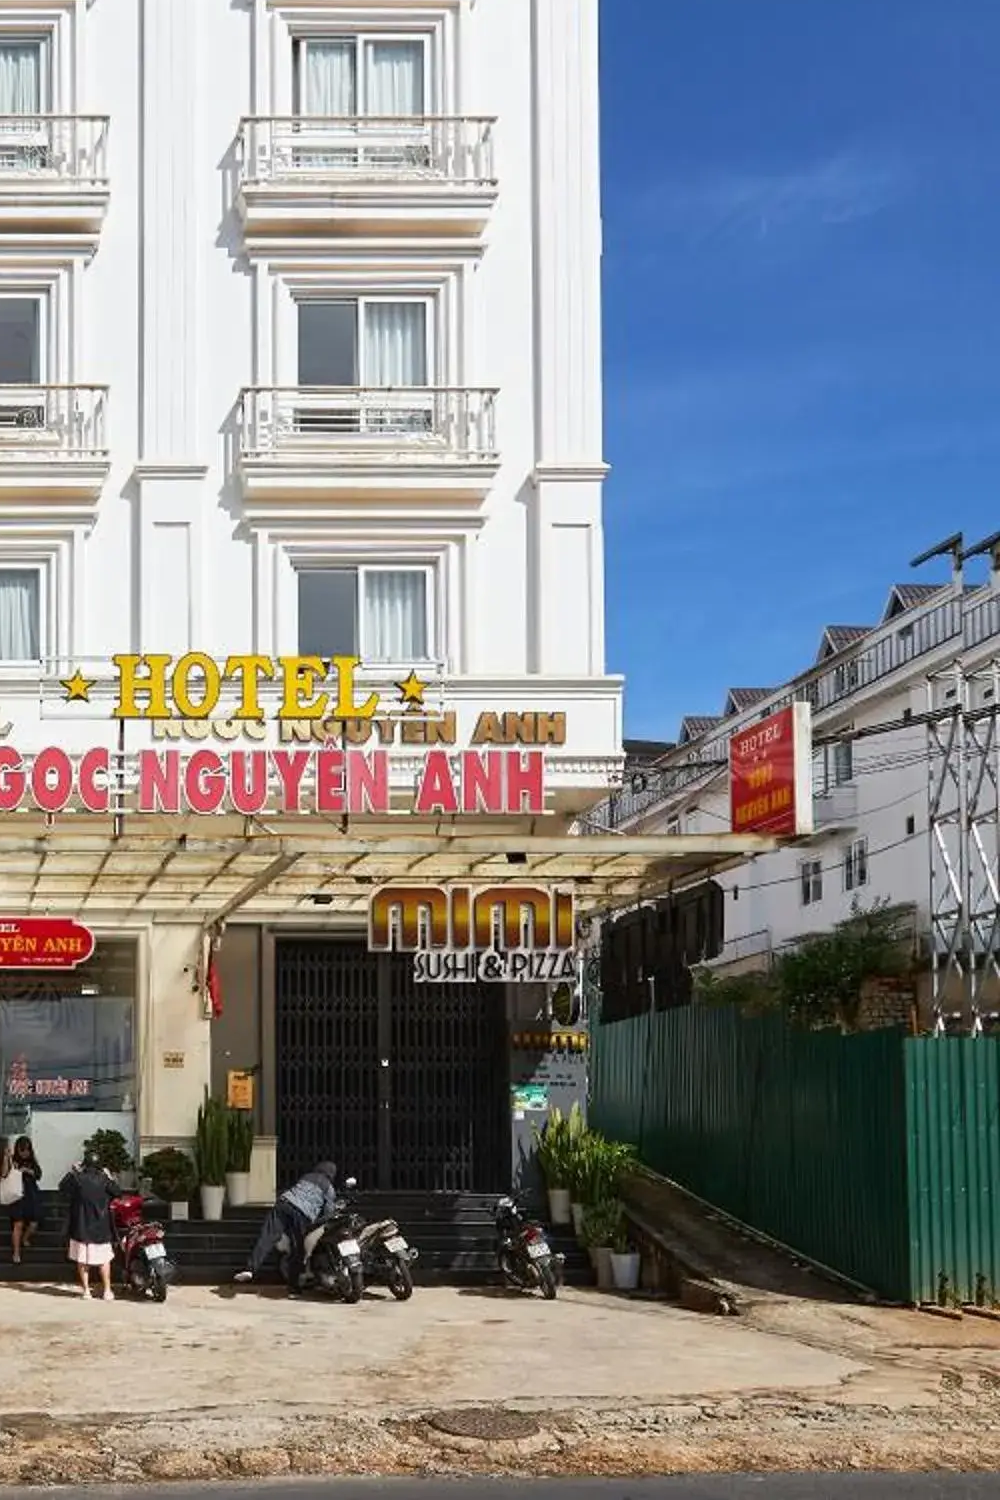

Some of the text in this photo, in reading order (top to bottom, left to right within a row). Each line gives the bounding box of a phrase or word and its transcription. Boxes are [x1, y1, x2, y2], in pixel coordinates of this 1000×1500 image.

[112, 652, 380, 720] HOTEL
[472, 711, 566, 744] ANH
[740, 724, 780, 756] HOTEL
[416, 750, 543, 814] ANH
[44, 937, 83, 953] ANH
[415, 952, 575, 981] SUSHI & PIZZA
